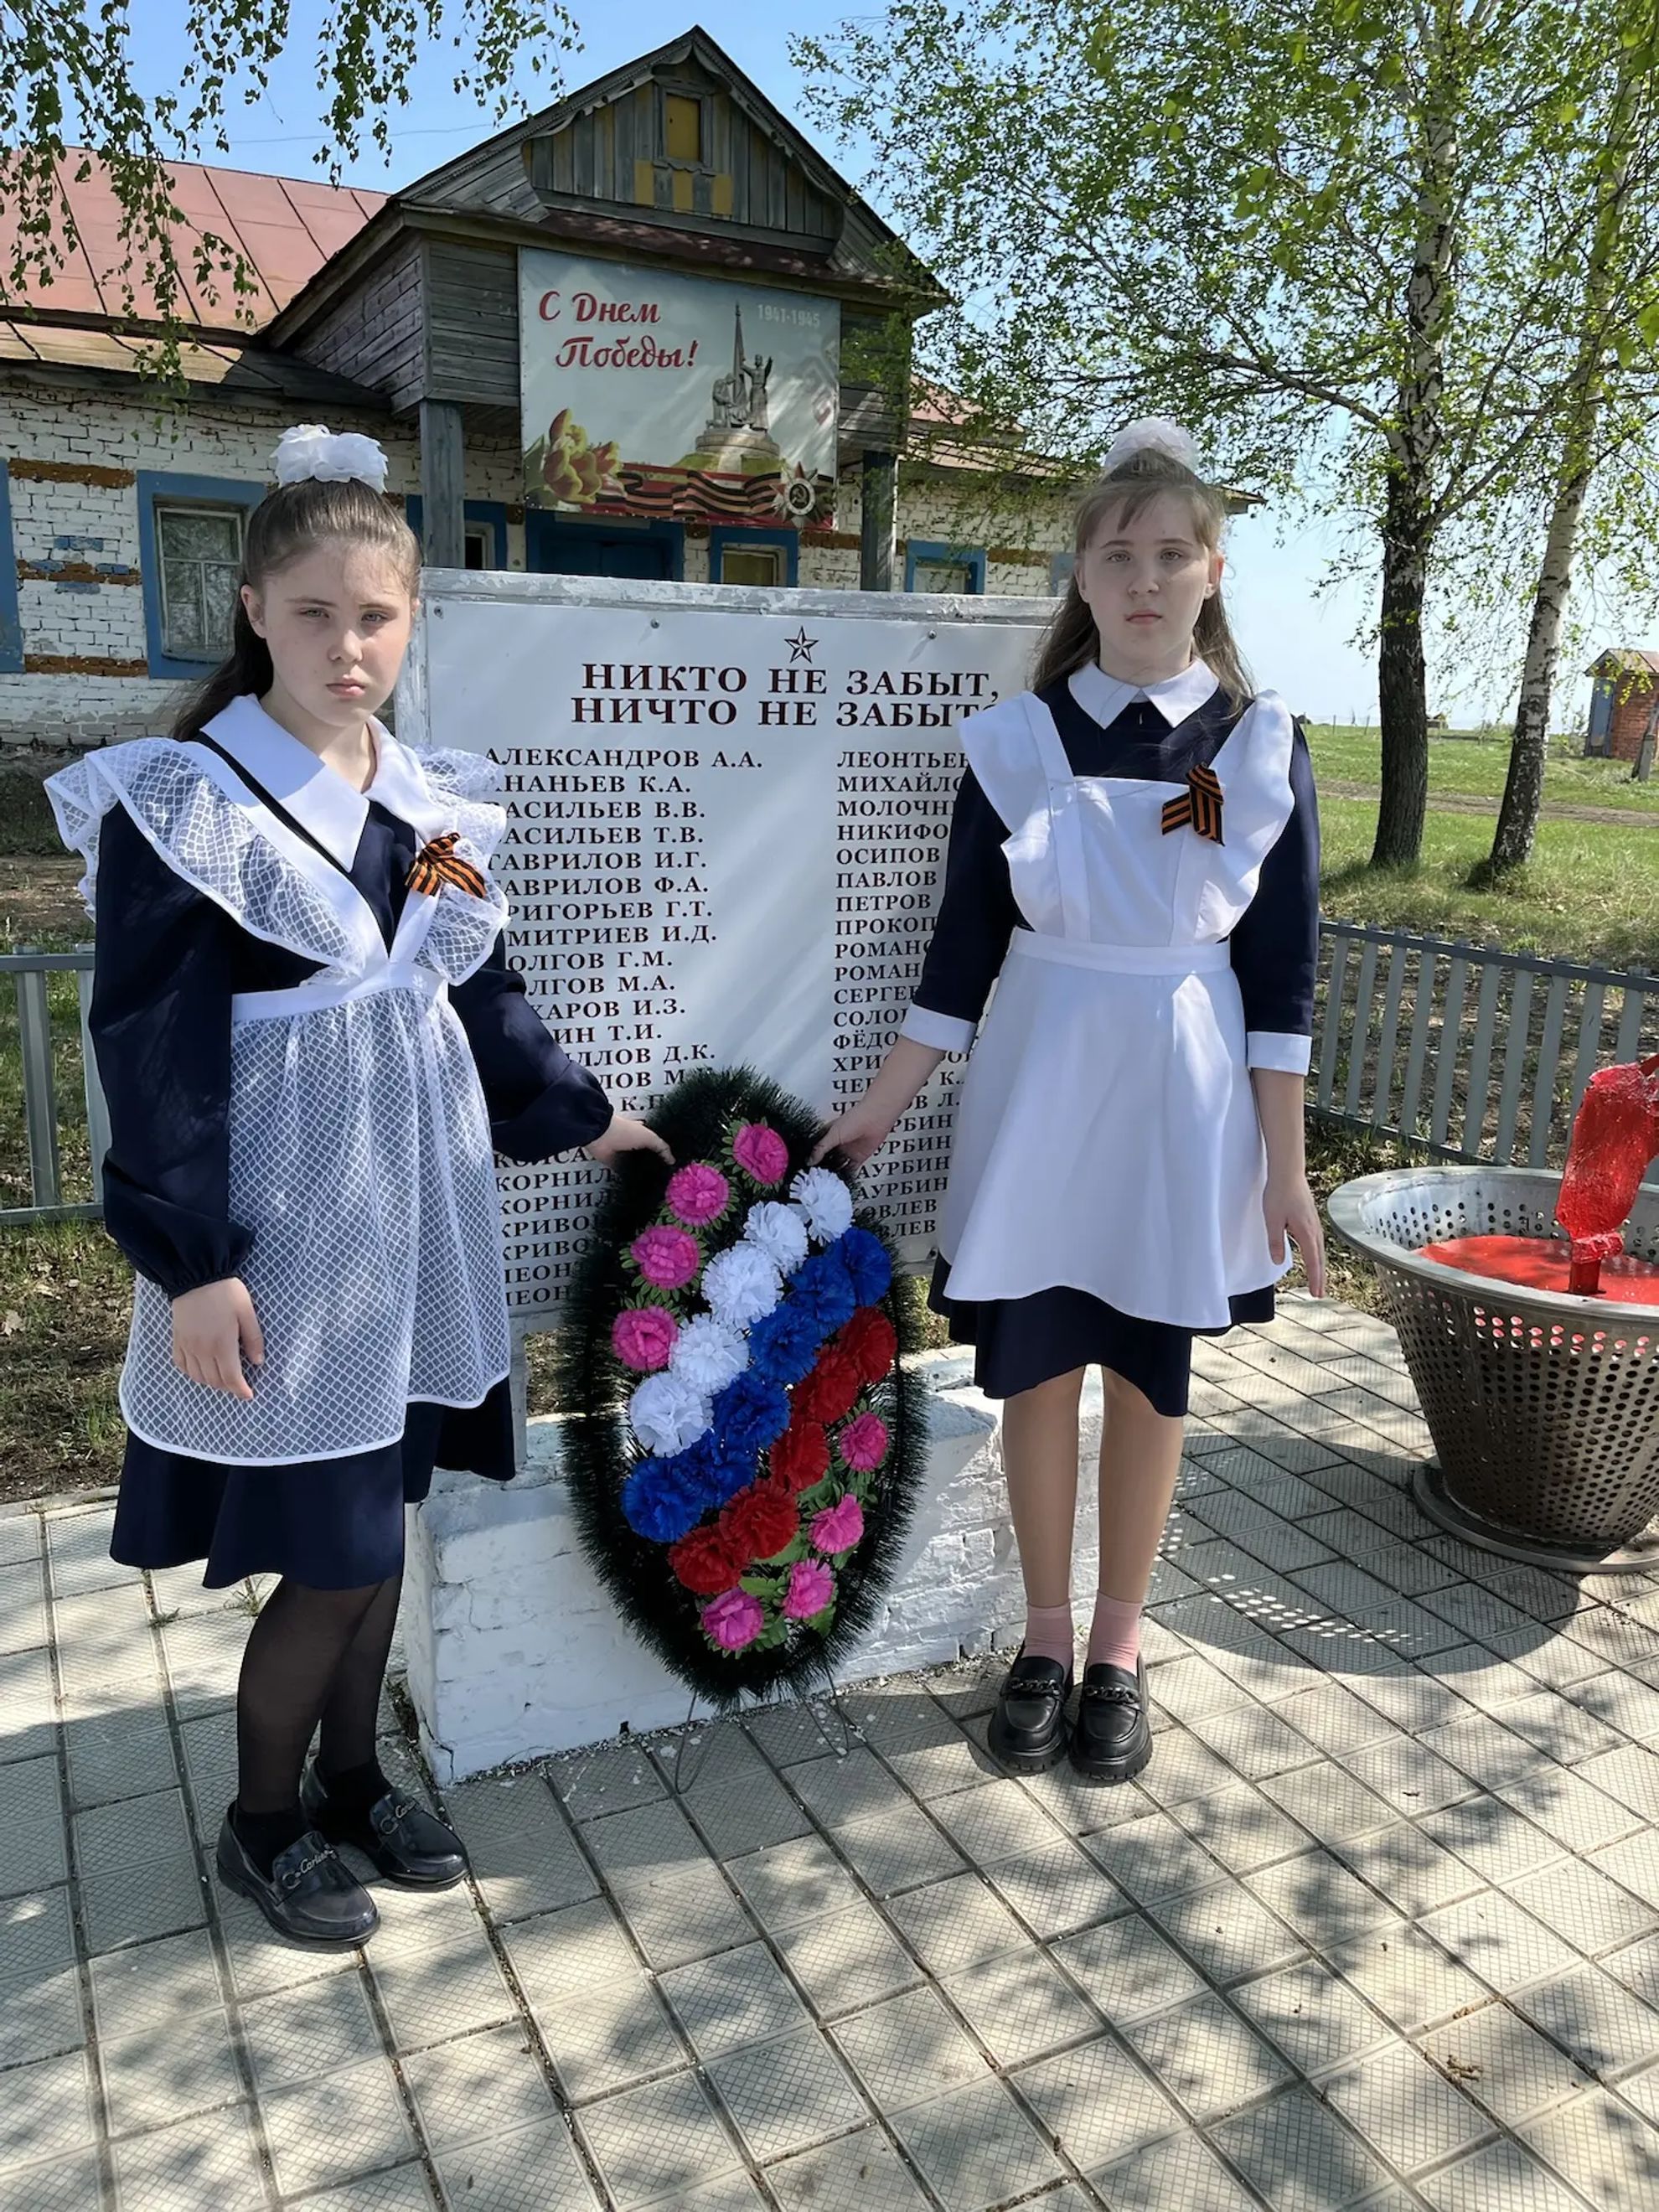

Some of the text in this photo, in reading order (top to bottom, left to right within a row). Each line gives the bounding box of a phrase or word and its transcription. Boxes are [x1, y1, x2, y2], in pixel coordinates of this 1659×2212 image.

[539, 291, 661, 323] С Днем
[556, 334, 699, 369] Победы!
[581, 663, 999, 702] НИКТО НЕ ЗАБЫТ,
[571, 697, 996, 727] НИЧТО НЕ ЗАБЫТ
[484, 748, 762, 771] АЛЕКСАНДРОВ А.А.
[495, 774, 691, 793] НАНЬЕВ К.А.
[483, 801, 705, 819] АСИЛЬЕВ В.В.
[837, 799, 955, 817] МОЛОЧН
[499, 826, 704, 845] АСИЛЬЕВ Т.В.
[837, 823, 949, 841] НИКИФО
[654, 851, 707, 869] И.Г.
[836, 847, 940, 866] ОСИПОВ
[654, 876, 709, 894] Ф.А.
[836, 870, 938, 889] ПАВЛОВ
[508, 901, 712, 922] РИГОРЬЕВ Г.Т.
[835, 893, 932, 913] ПЕТРОВ
[507, 925, 716, 947] МИТРИЕВ И.Д.
[835, 916, 938, 937] ПРОКОП
[508, 950, 673, 972] ОЛГОВ Г.М.
[834, 962, 922, 983] РОМАН
[528, 974, 675, 996] ЛГОВ М.А.
[633, 998, 686, 1016] И.З.
[607, 1024, 662, 1041] Т.И.
[832, 1029, 900, 1052] ФЁДО
[663, 1044, 716, 1065] Д.К.
[664, 1068, 685, 1086] М
[890, 1114, 954, 1133] РБИН
[855, 1156, 951, 1180] АУРБИН
[495, 1167, 612, 1192] КОРНИЛ
[856, 1176, 949, 1200] АУРБИН
[499, 1190, 611, 1215] КОРНИЛ
